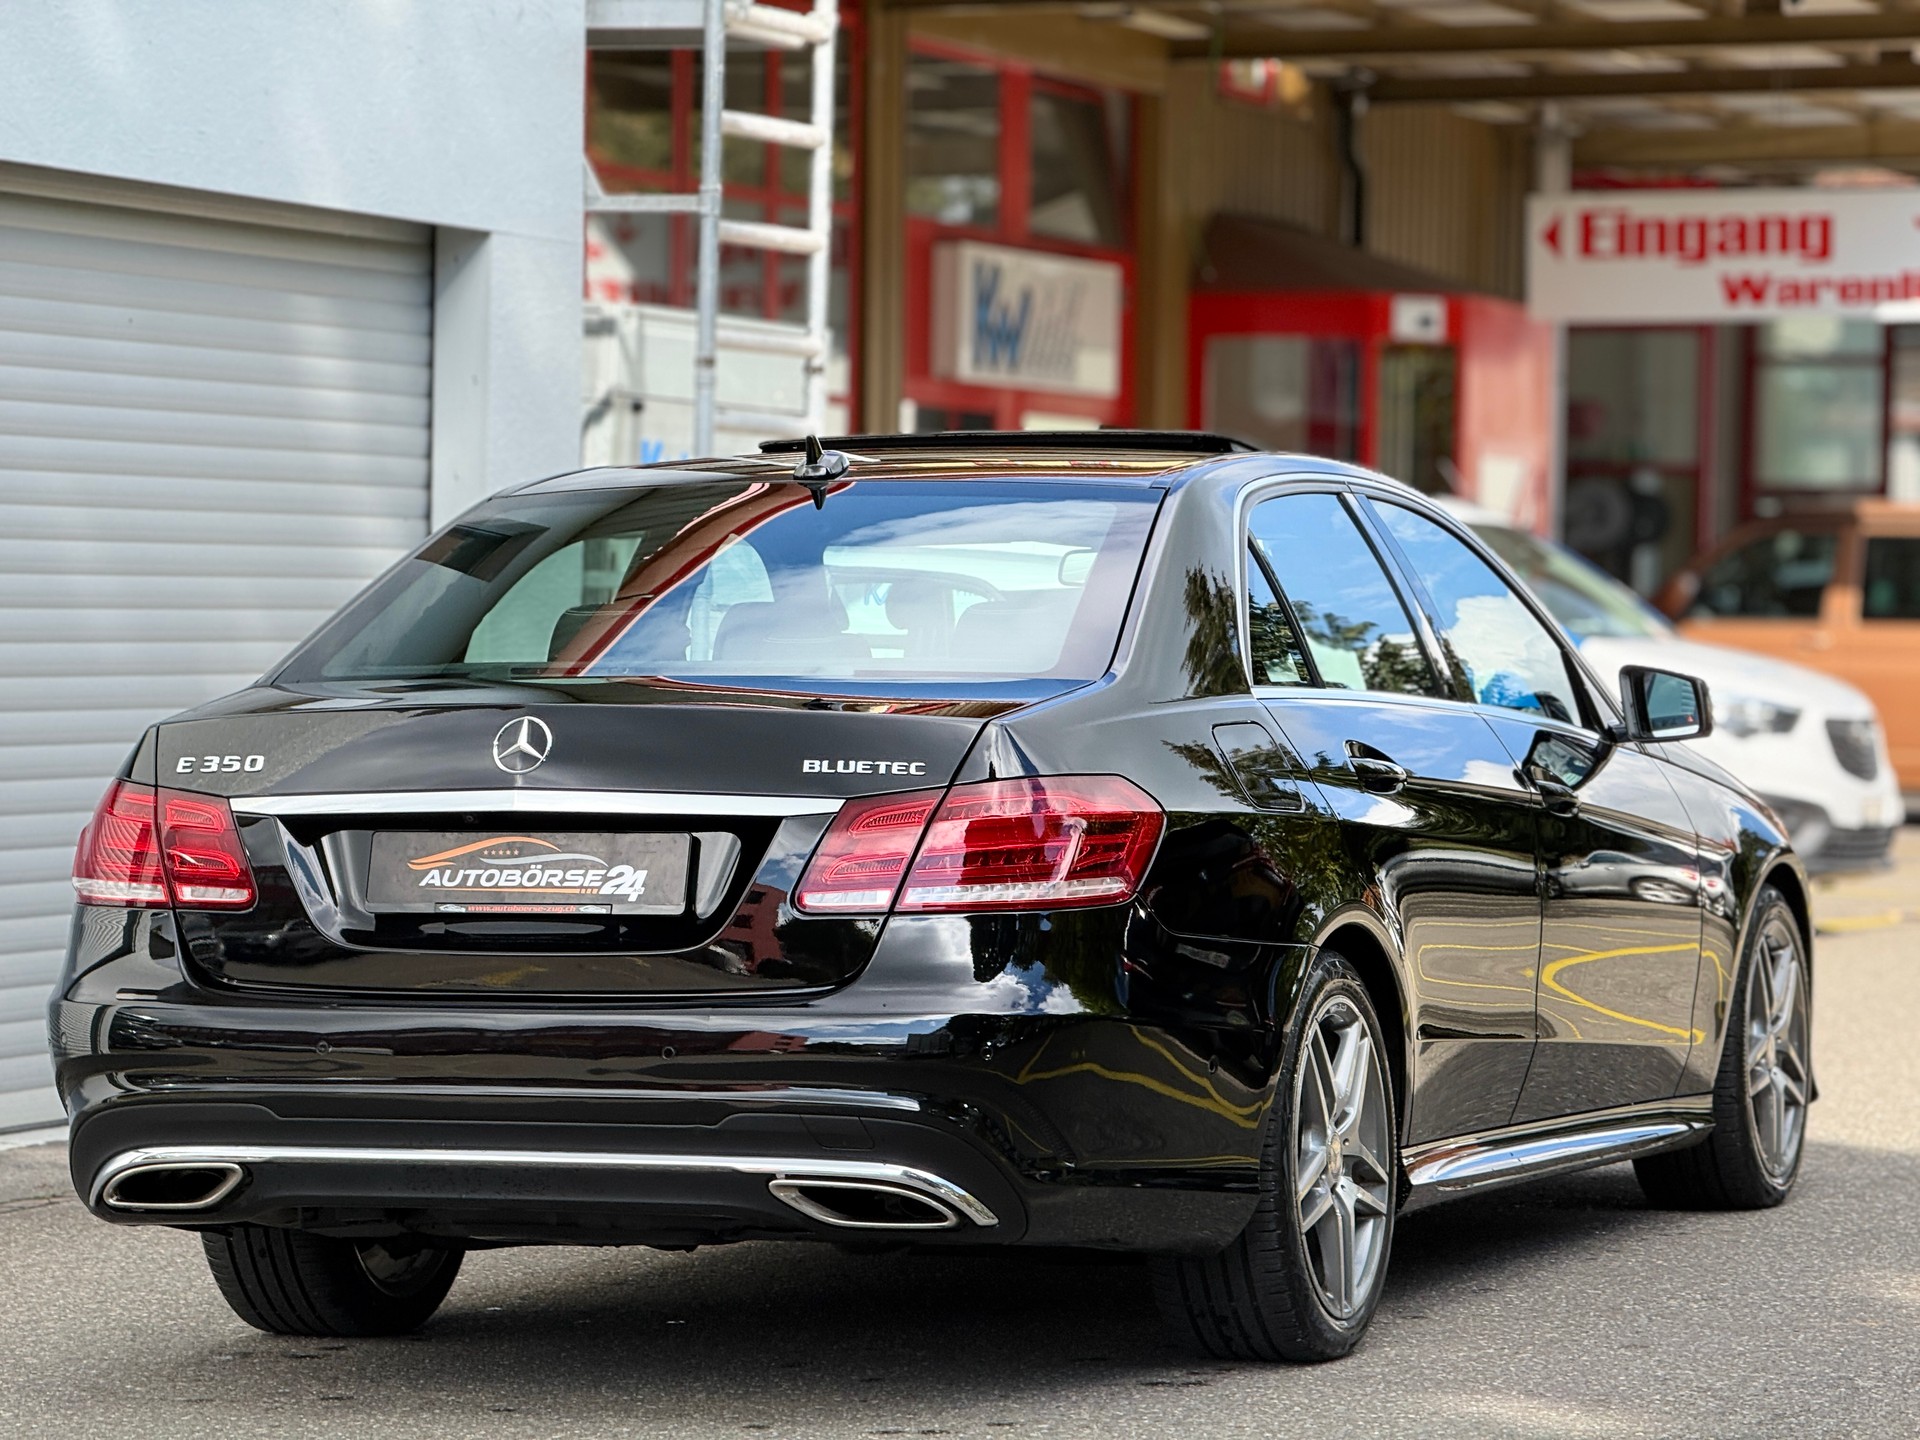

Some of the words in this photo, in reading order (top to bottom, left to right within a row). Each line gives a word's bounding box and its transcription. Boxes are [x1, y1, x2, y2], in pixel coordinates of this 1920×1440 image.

[1577, 210, 1833, 262] Eingang
[176, 756, 196, 773] E
[200, 754, 265, 773] 350
[802, 759, 926, 775] BLUETEC
[467, 903, 577, 914] www.autoboerse-zug.ch
